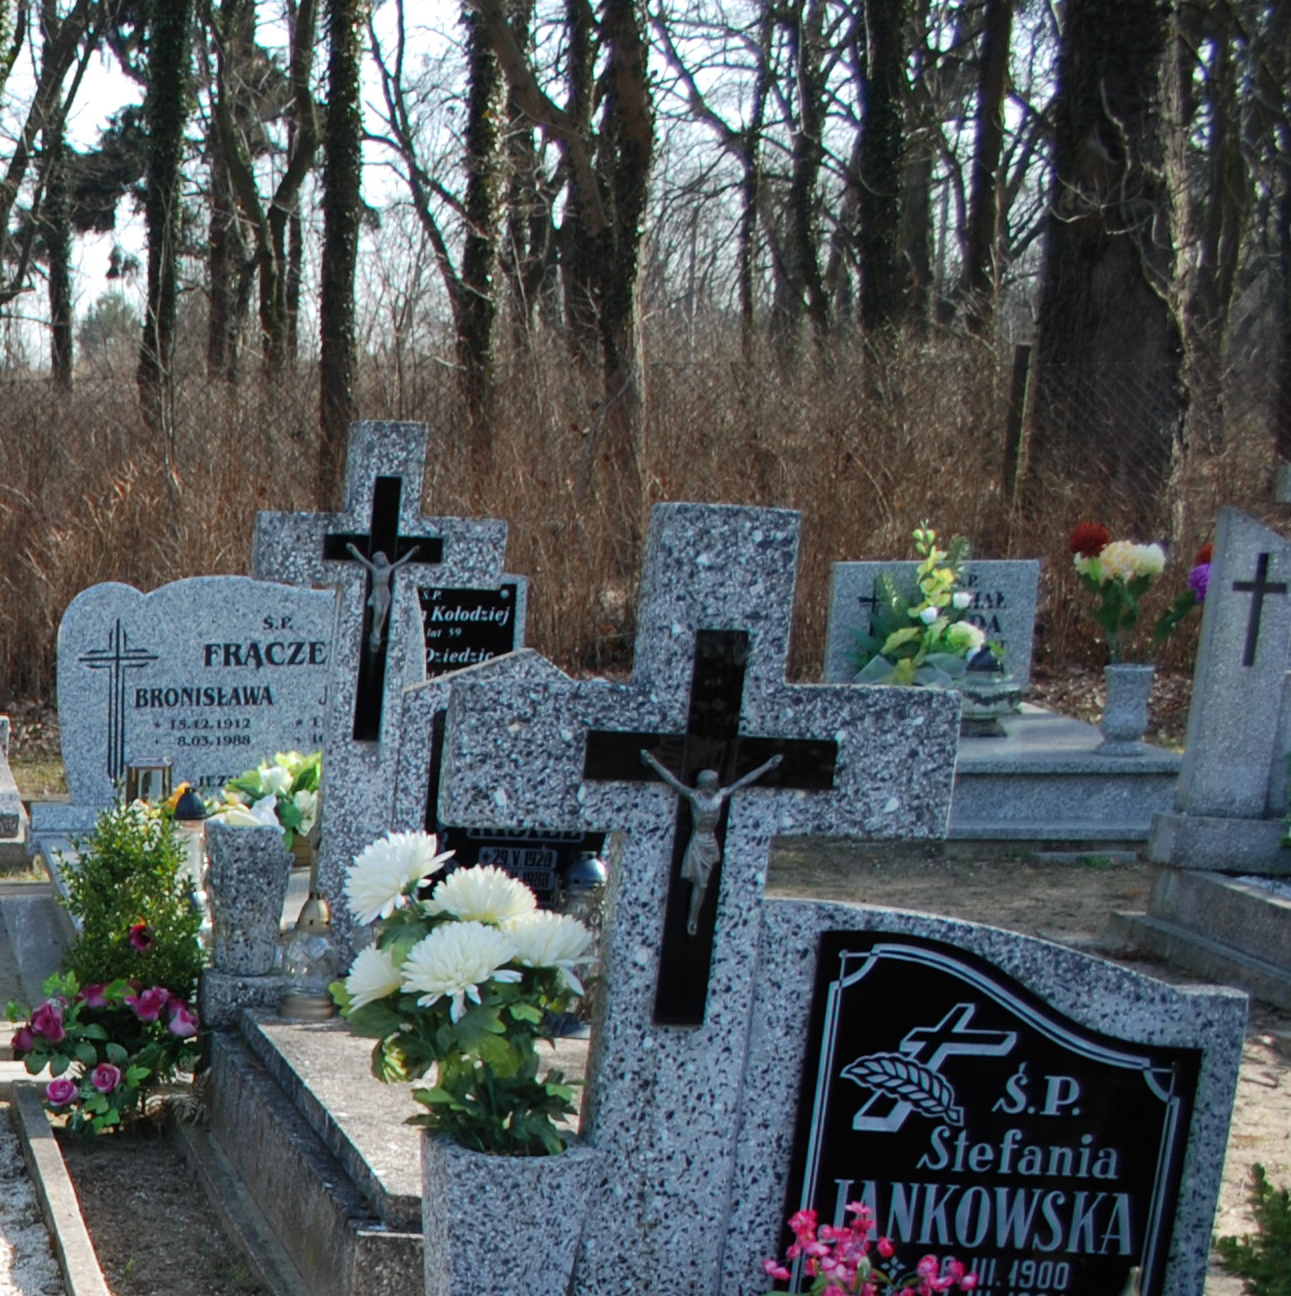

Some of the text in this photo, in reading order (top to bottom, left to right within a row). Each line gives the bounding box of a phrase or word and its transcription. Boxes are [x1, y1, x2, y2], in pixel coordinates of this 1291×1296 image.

[431, 605, 511, 627] Kołodziej
[134, 685, 273, 709] BRONISŁAWA
[916, 1125, 1120, 1180] Stefania
[1008, 1258, 1071, 1291] 1900
